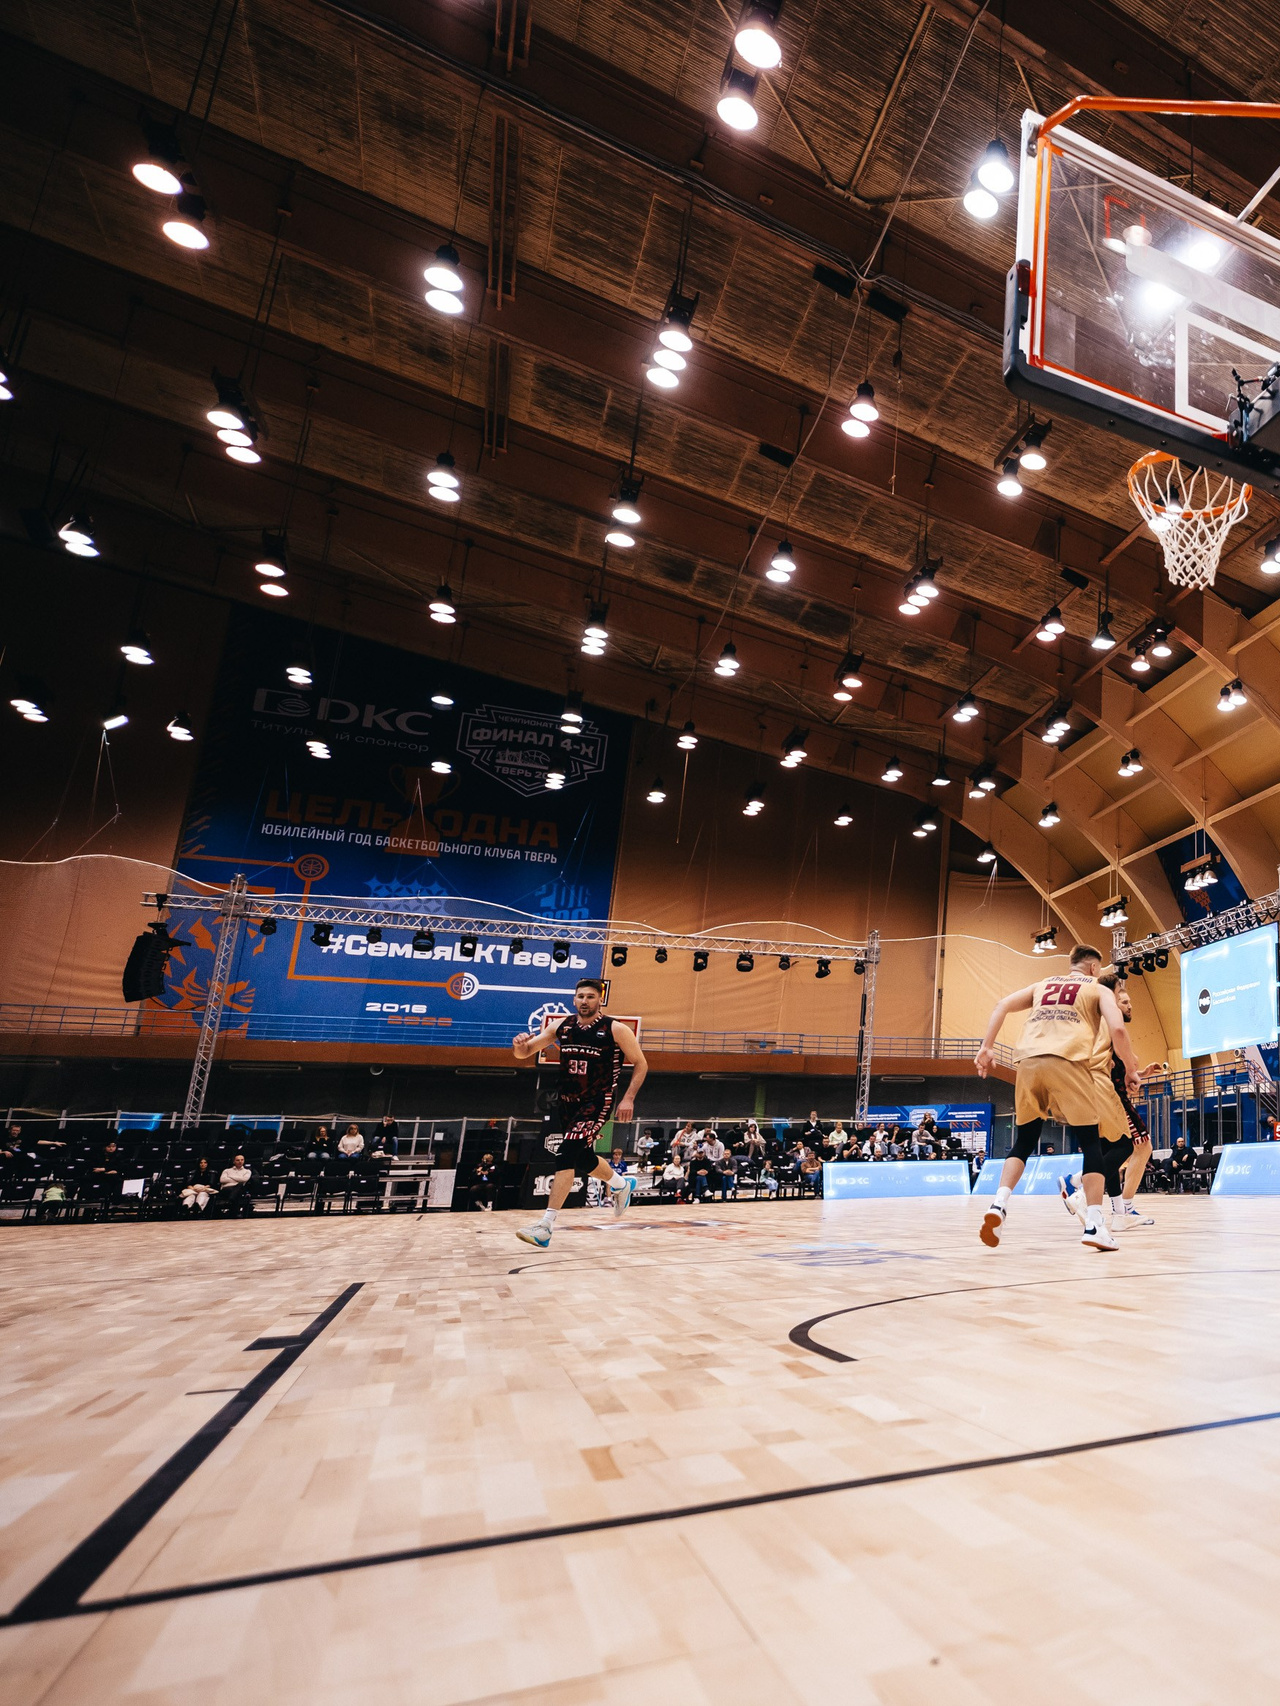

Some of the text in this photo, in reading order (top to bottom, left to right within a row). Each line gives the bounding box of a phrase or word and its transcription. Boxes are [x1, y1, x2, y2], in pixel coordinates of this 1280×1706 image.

[316, 697, 433, 736] DKC
[497, 714, 554, 729] ЧЕМПИОНАТ
[355, 735, 430, 753] спонсор
[472, 726, 555, 748] ФИНАЛ
[494, 765, 533, 778] ТВЕРЬ
[264, 789, 559, 850] ЦЕЛЬ ОДНА
[261, 823, 558, 864] ЮБИЛЕЙНЫЙ ГОД БАСКЕТБОЛЬНОГО КЛУБА ТВЕРЬ
[1041, 983, 1081, 1006] 28
[365, 1002, 428, 1014] 2016
[568, 1059, 588, 1075] 33
